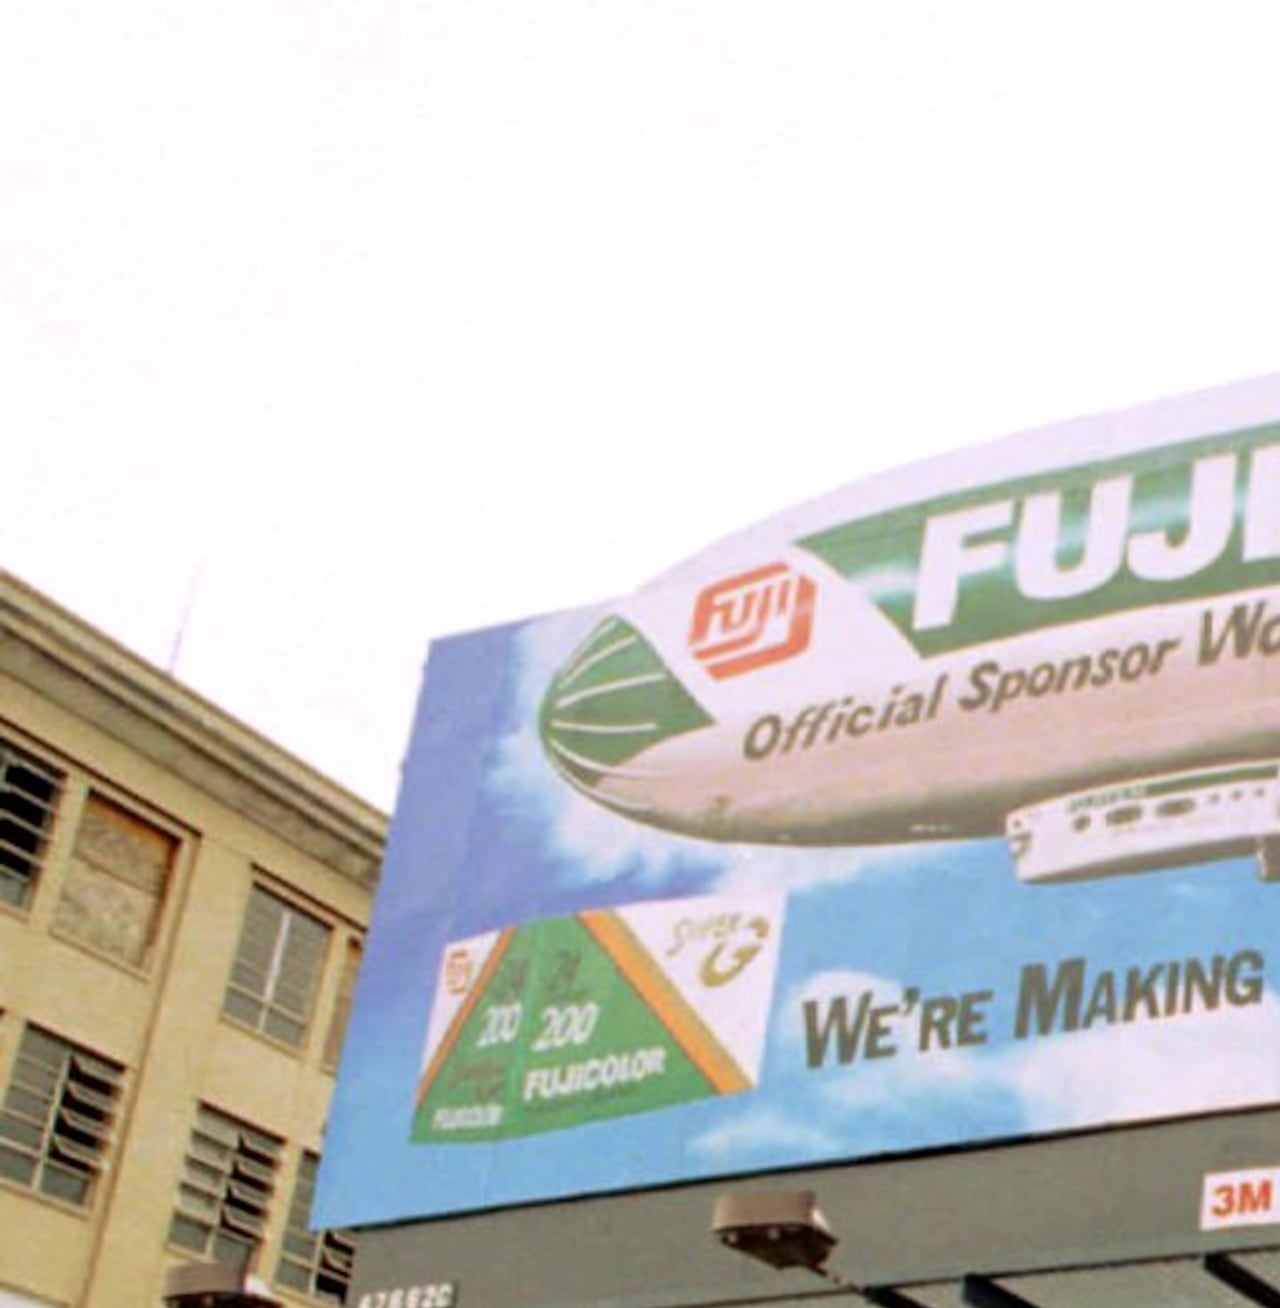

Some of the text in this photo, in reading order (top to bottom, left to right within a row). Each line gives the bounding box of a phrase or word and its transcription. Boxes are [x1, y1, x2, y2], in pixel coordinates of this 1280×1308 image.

[692, 572, 802, 664] FUJI
[742, 682, 943, 762] Official
[958, 635, 1182, 711] Sponsor
[530, 1001, 600, 1053] 200
[801, 988, 994, 1070] WE'RE
[1014, 948, 1265, 1041] MAKING
[523, 1047, 668, 1101] FUJICOLOR
[1210, 1179, 1273, 1218] 3M
